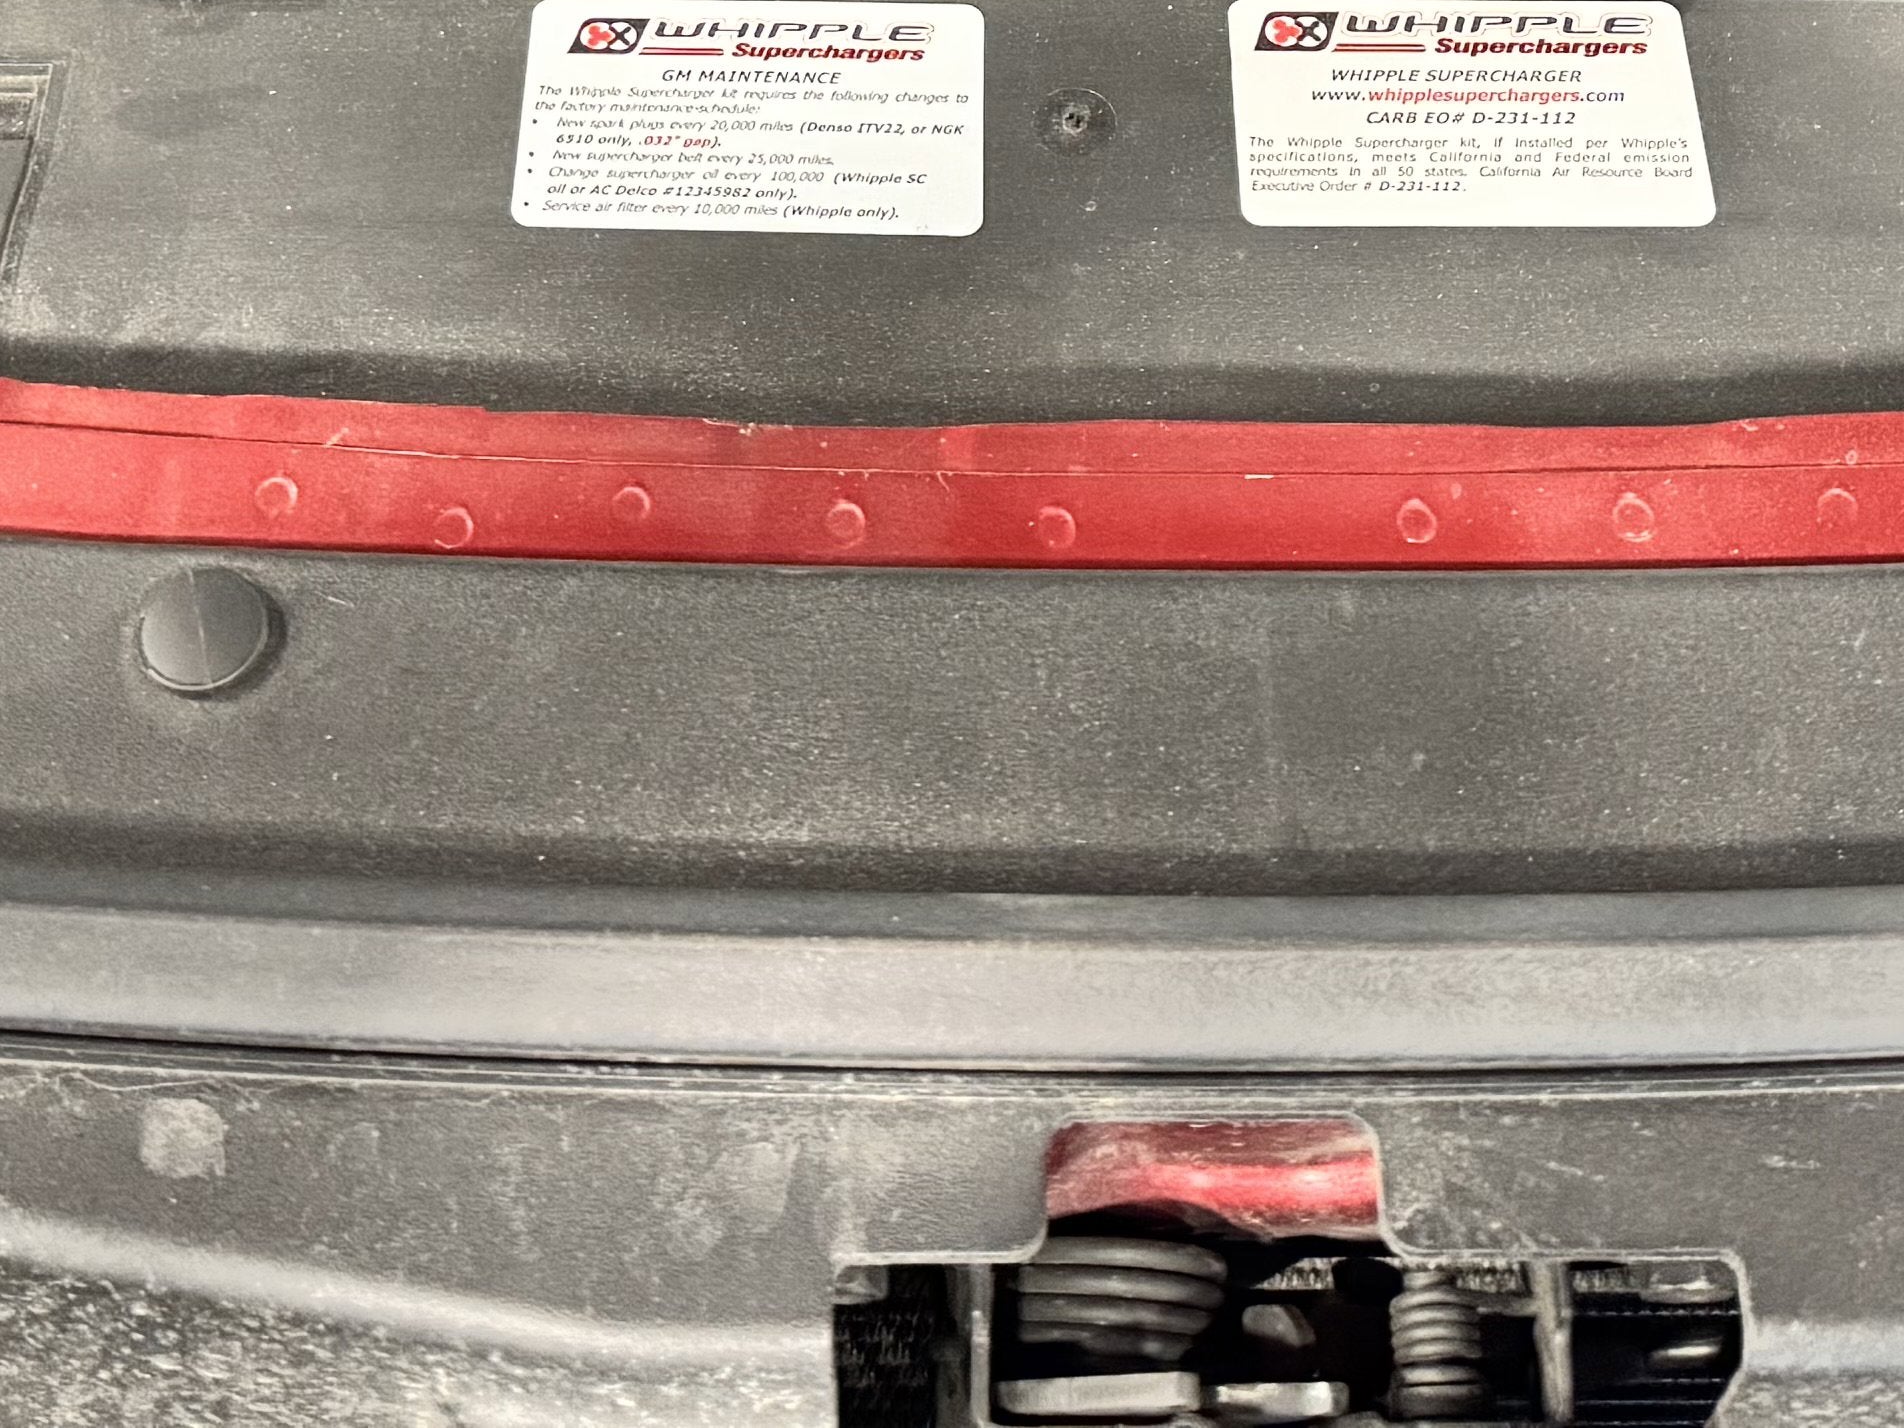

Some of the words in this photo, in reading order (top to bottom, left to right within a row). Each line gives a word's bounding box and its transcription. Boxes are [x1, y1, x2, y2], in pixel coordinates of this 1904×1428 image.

[655, 22, 931, 41] WHIPPLE
[1346, 15, 1647, 34] WHIPPLE
[732, 43, 925, 63] Superchargers
[1435, 38, 1648, 57] Superchargers
[661, 69, 691, 82] GM
[699, 70, 842, 84] MAINTENANCE
[1331, 69, 1420, 82] WHIPPLE
[1425, 69, 1582, 83] SUPERCHARGER
[1311, 88, 1625, 104] www.whipplesuperchargers.com
[1366, 111, 1416, 124] CARB
[1424, 112, 1465, 124] EO#
[1472, 112, 1576, 125] D-231-112
[800, 122, 852, 134] (Denso
[931, 125, 964, 134] NGK
[598, 135, 632, 146] only,
[833, 173, 902, 185] (Whipple
[906, 174, 928, 184] SC
[570, 185, 585, 194] or
[590, 185, 611, 195] AC
[616, 186, 657, 195] Delco
[755, 188, 797, 200] only).
[783, 206, 851, 218] (Whipple
[857, 207, 899, 220] only).
